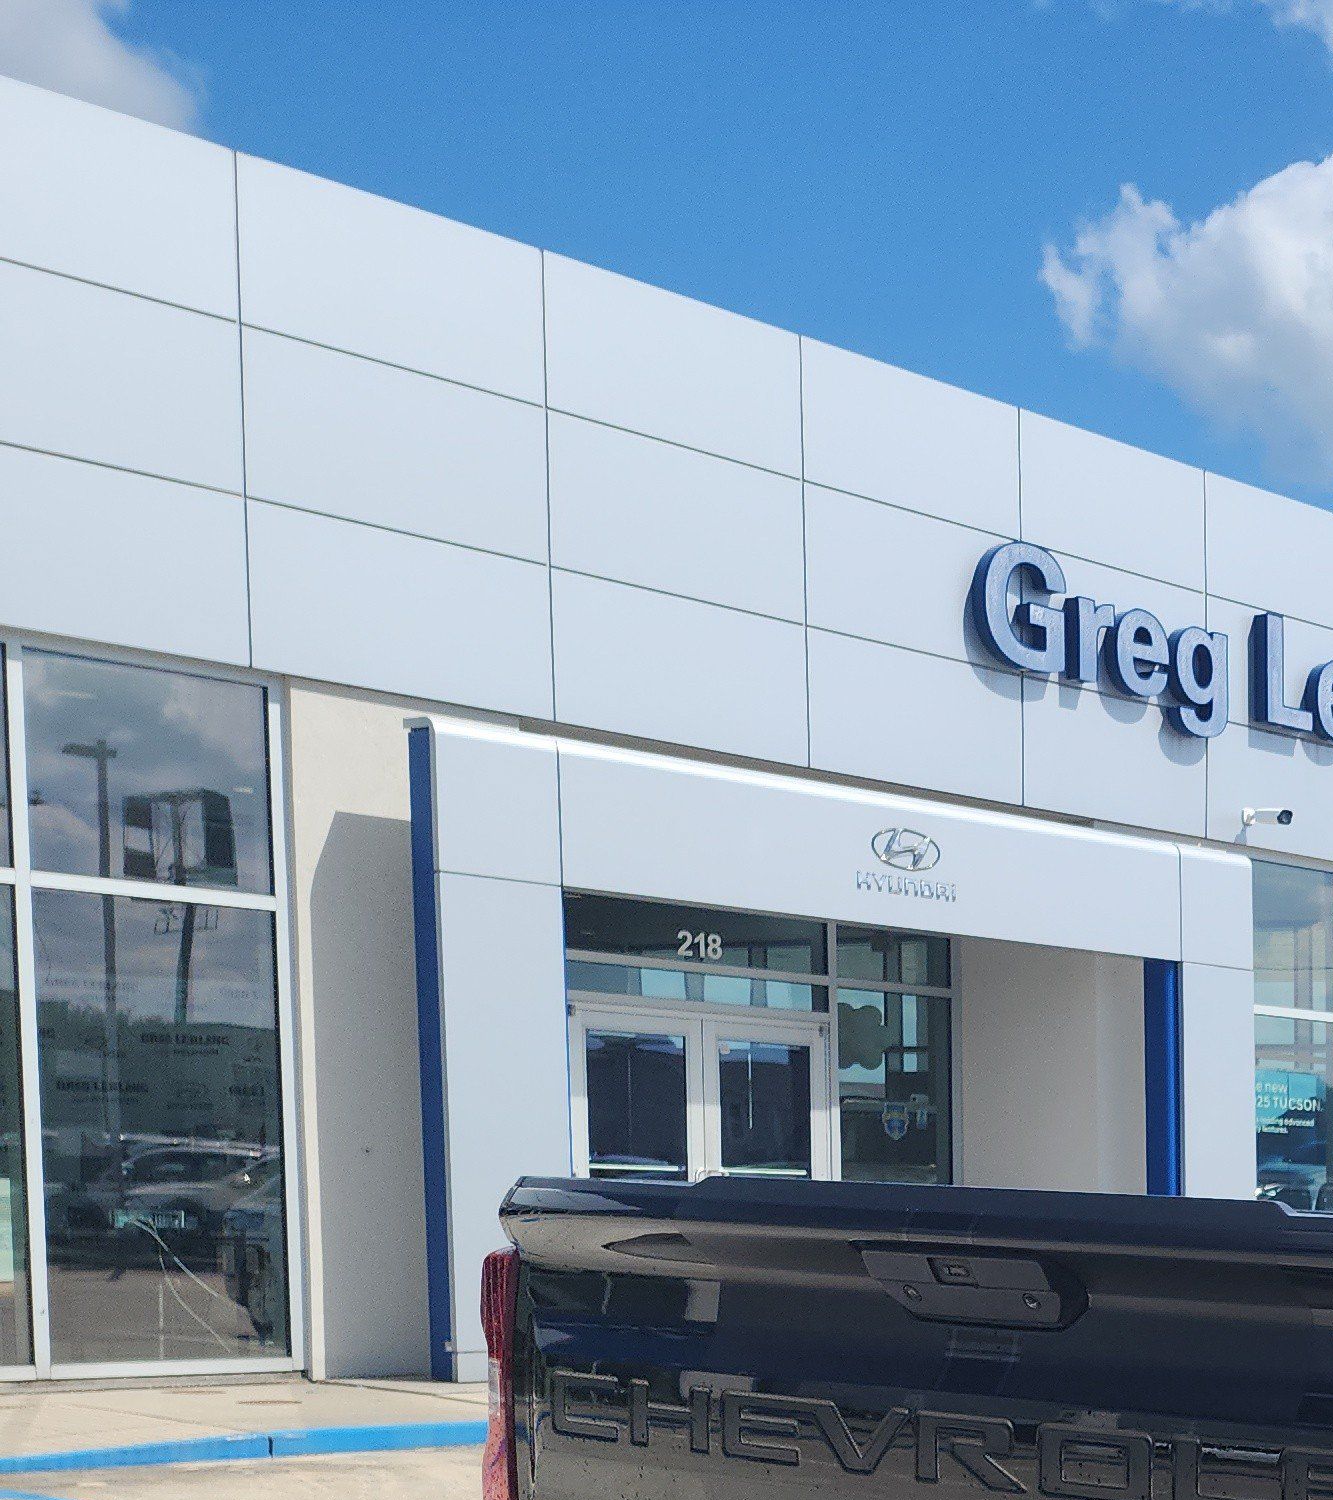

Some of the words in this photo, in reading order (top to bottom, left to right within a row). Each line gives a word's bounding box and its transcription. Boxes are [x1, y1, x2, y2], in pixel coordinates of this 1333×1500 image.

[967, 540, 1229, 738] Greg
[856, 870, 957, 903] HYUNDAI
[676, 929, 723, 961] 218
